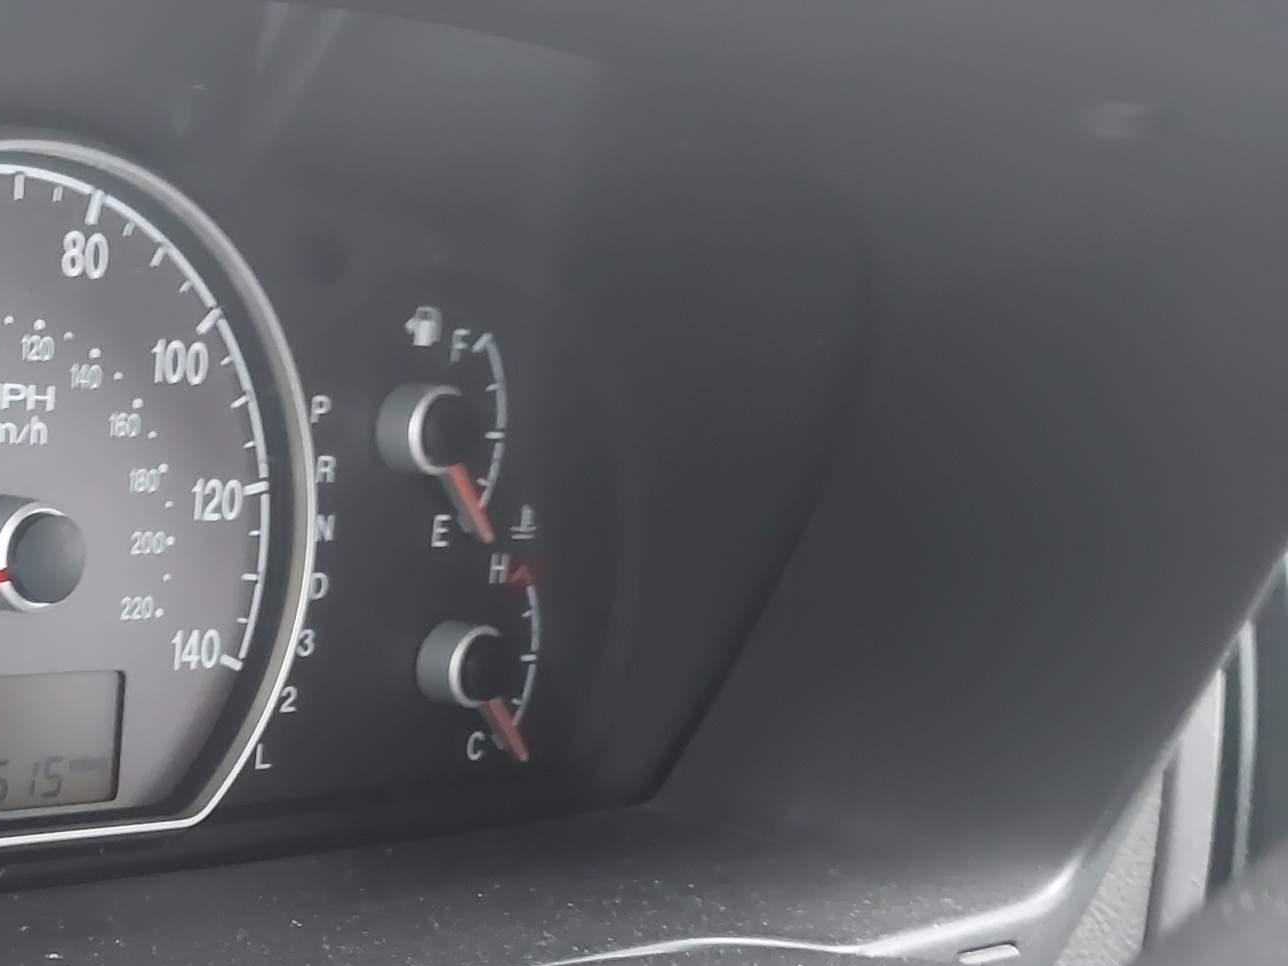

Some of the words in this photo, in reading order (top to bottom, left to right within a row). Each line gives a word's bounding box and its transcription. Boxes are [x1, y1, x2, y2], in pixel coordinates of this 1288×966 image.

[62, 230, 109, 279] 80
[21, 334, 55, 362] 120
[450, 328, 471, 362] F
[151, 340, 209, 385] 100
[311, 395, 332, 422] P
[316, 455, 336, 484] R
[192, 479, 243, 521] 120
[314, 514, 334, 542] N
[431, 514, 450, 548] E
[130, 530, 166, 555] 200
[489, 553, 508, 584] H
[312, 573, 329, 600] D
[120, 595, 154, 621] 220
[171, 629, 222, 671] 140
[296, 630, 316, 657] 3
[279, 687, 298, 713] 2
[255, 744, 272, 769] L
[466, 732, 485, 761] C
